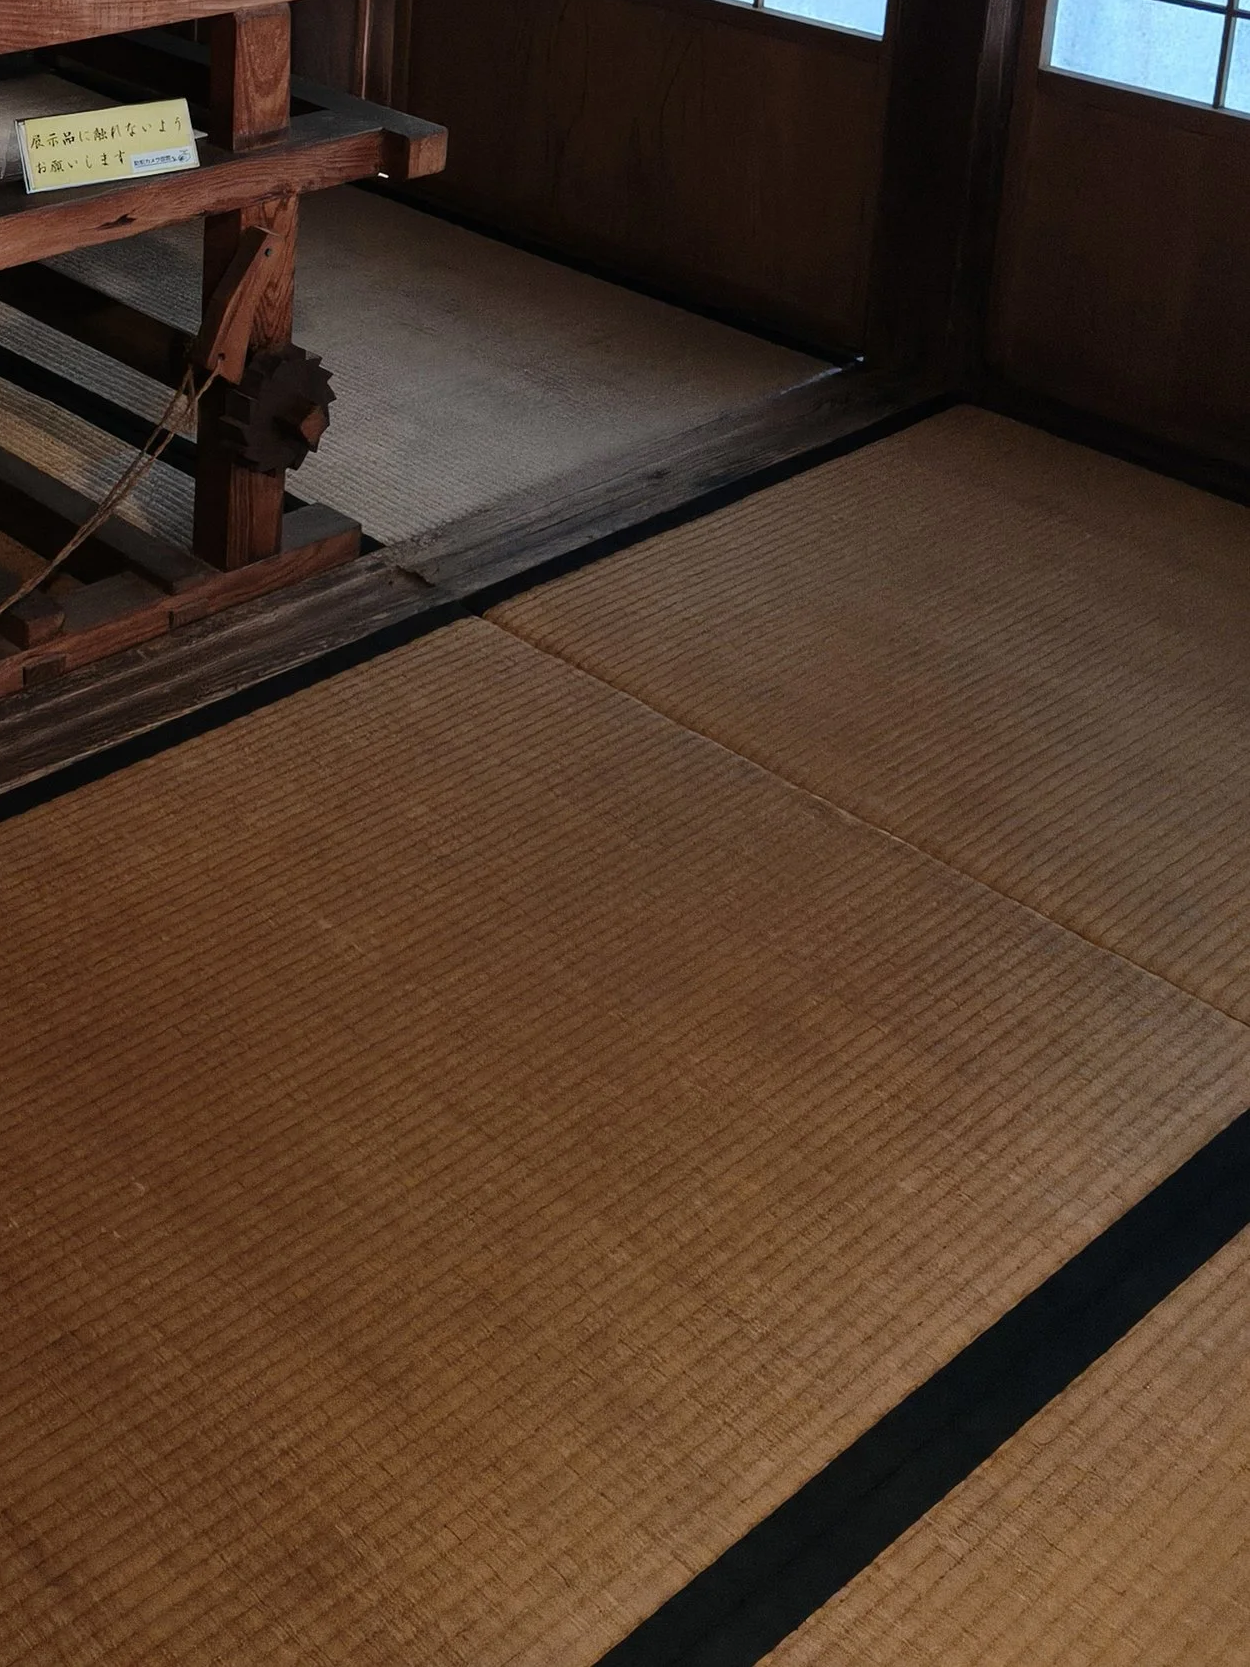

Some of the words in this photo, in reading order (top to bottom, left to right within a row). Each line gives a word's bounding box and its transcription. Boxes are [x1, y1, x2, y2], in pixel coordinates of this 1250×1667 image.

[30, 116, 183, 150] 展示品に触れないよう
[36, 150, 126, 174] お願いします
